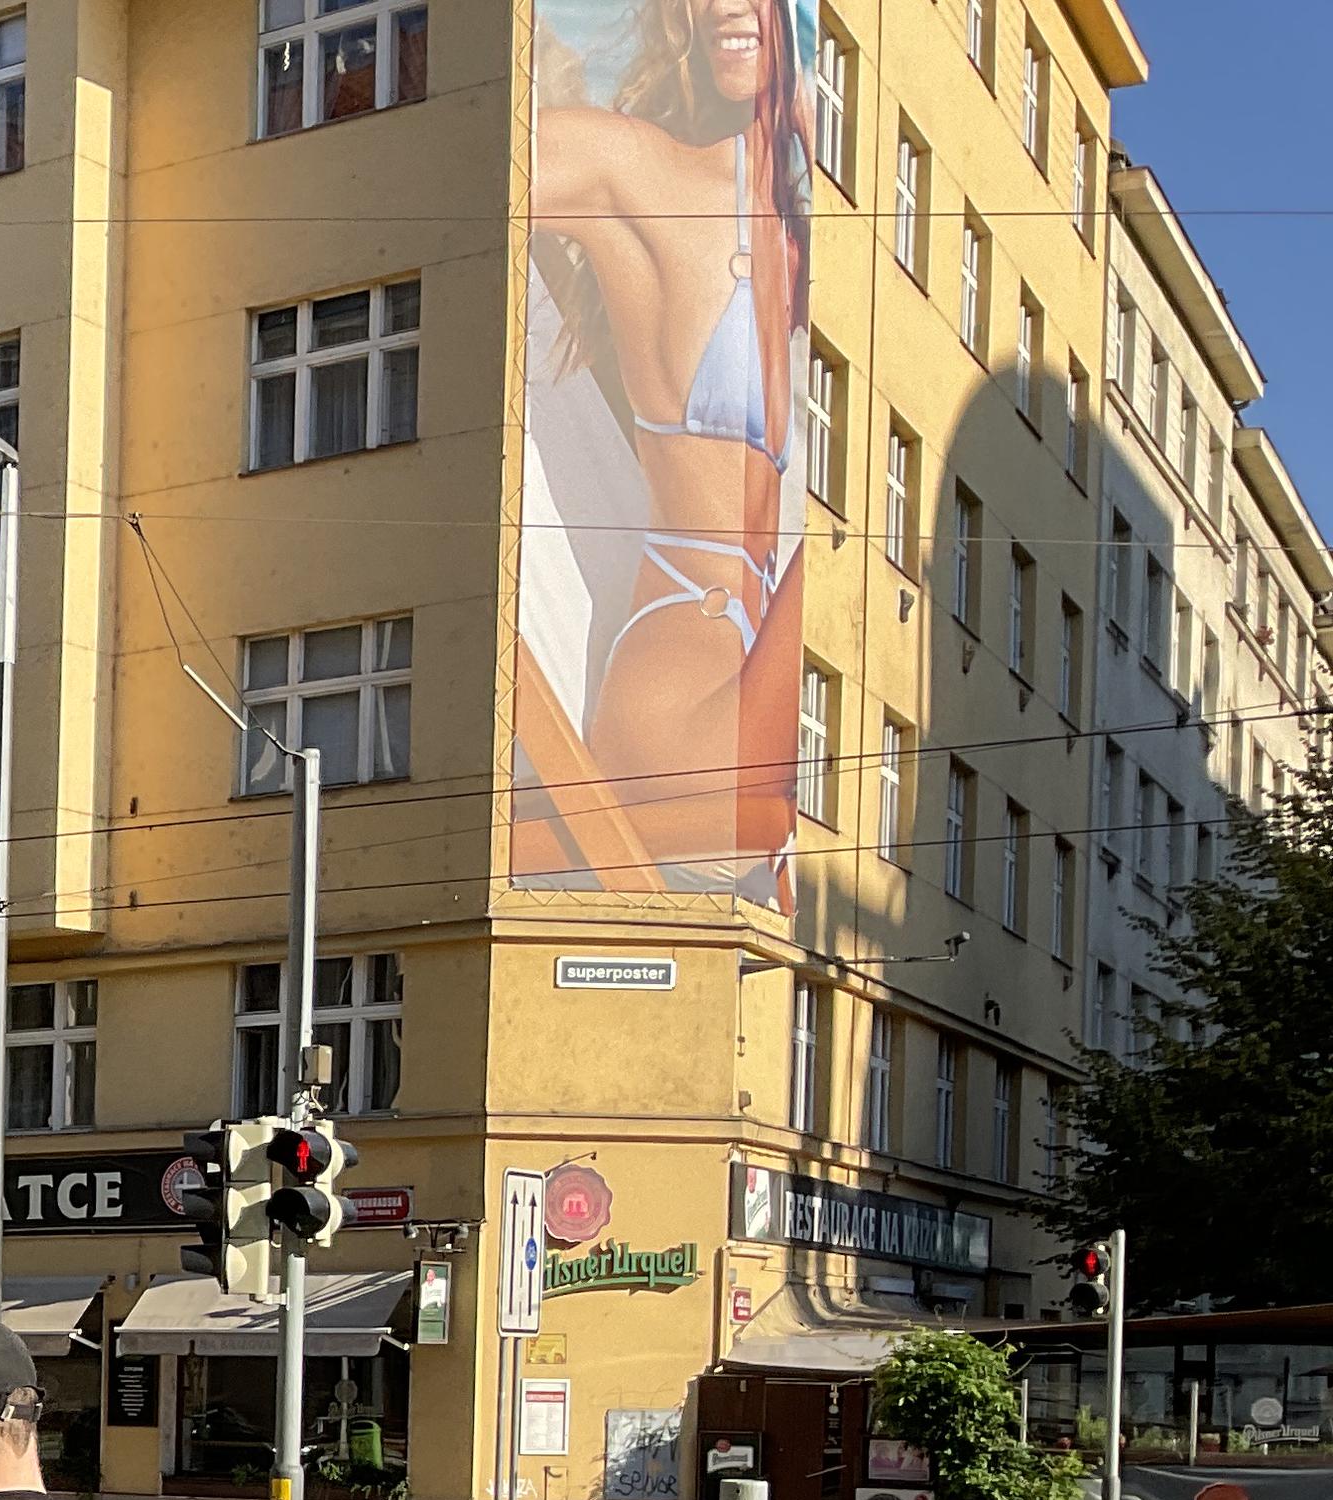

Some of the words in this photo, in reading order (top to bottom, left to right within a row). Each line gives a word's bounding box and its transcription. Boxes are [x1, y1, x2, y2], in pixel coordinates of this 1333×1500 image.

[566, 966, 666, 982] superposter
[784, 1191, 875, 1249] RESTAURACE
[880, 1210, 900, 1254] NA
[544, 1250, 611, 1290] ilsner
[605, 1237, 698, 1288] Urquell
